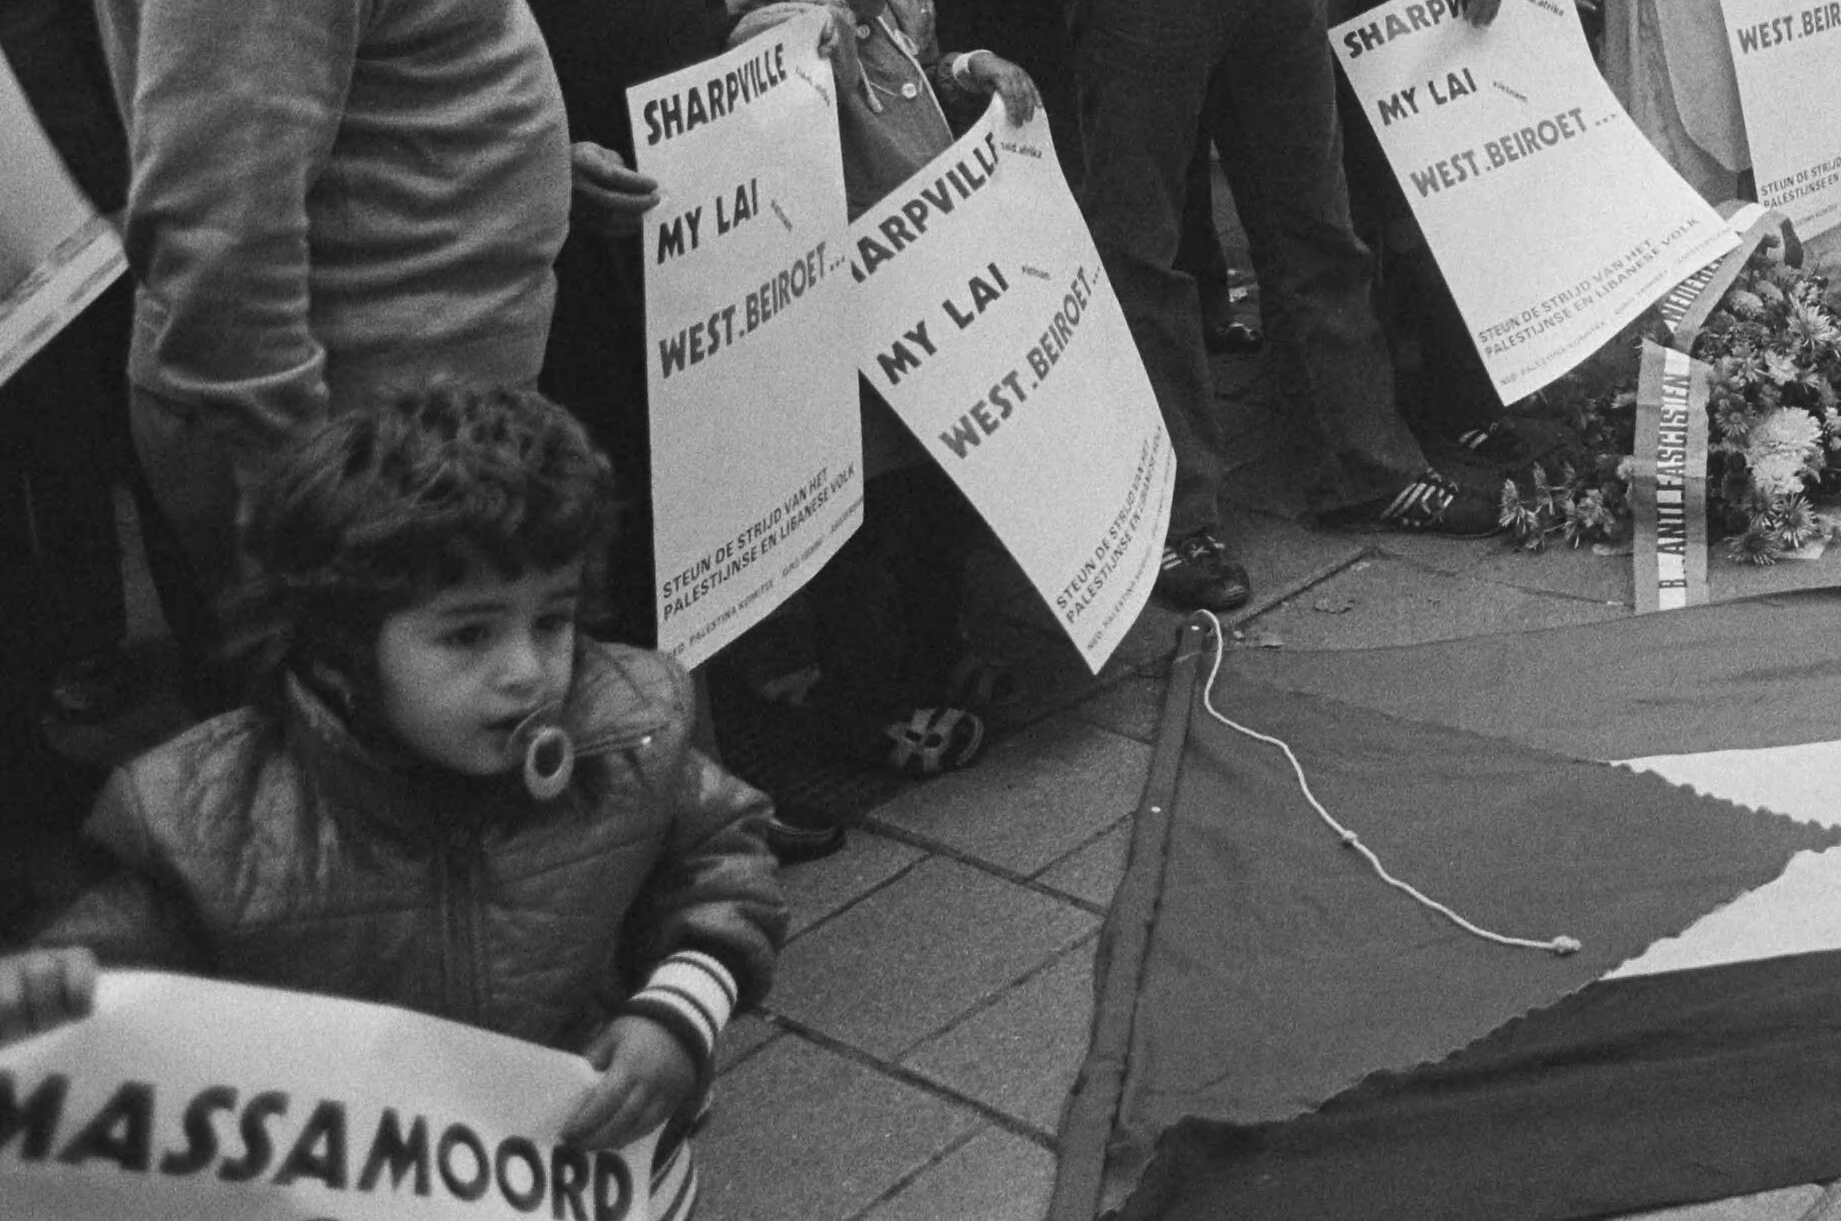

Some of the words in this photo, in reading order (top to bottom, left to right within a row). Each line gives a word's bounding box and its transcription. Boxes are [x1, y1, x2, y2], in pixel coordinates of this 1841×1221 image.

[643, 42, 787, 146] SHARPVILLE
[1376, 90, 1417, 126] MY
[1428, 67, 1478, 108] LAI
[656, 204, 703, 265] MY
[715, 178, 759, 231] LAI
[1761, 175, 1794, 197] STEUN
[875, 320, 938, 386] MY
[941, 262, 1010, 332] LAI
[1478, 316, 1522, 344] STEUN
[1522, 307, 1541, 324] DE
[1541, 278, 1593, 314] STRIJD
[1592, 259, 1624, 284] VAN
[1625, 238, 1652, 264] HET
[1484, 308, 1572, 357] PALESTIJNSE
[1573, 296, 1595, 313] EN
[1663, 217, 1700, 247] VOLK
[663, 555, 713, 599] STEUN
[715, 540, 735, 565] DE
[737, 507, 783, 550] STRIJD
[784, 488, 808, 515] VAN
[809, 466, 829, 495] HET
[663, 546, 759, 622] PALESTIJNSE
[760, 534, 779, 556] EN
[779, 487, 831, 541] LIBANESE
[830, 464, 855, 494] VOLK
[1056, 556, 1098, 610] STEUN
[1094, 536, 1112, 561] DE
[1109, 490, 1136, 540] STRIJD
[1066, 530, 1133, 625] PALESTIJNSE
[0, 1074, 633, 1221] MASSAMOORD
